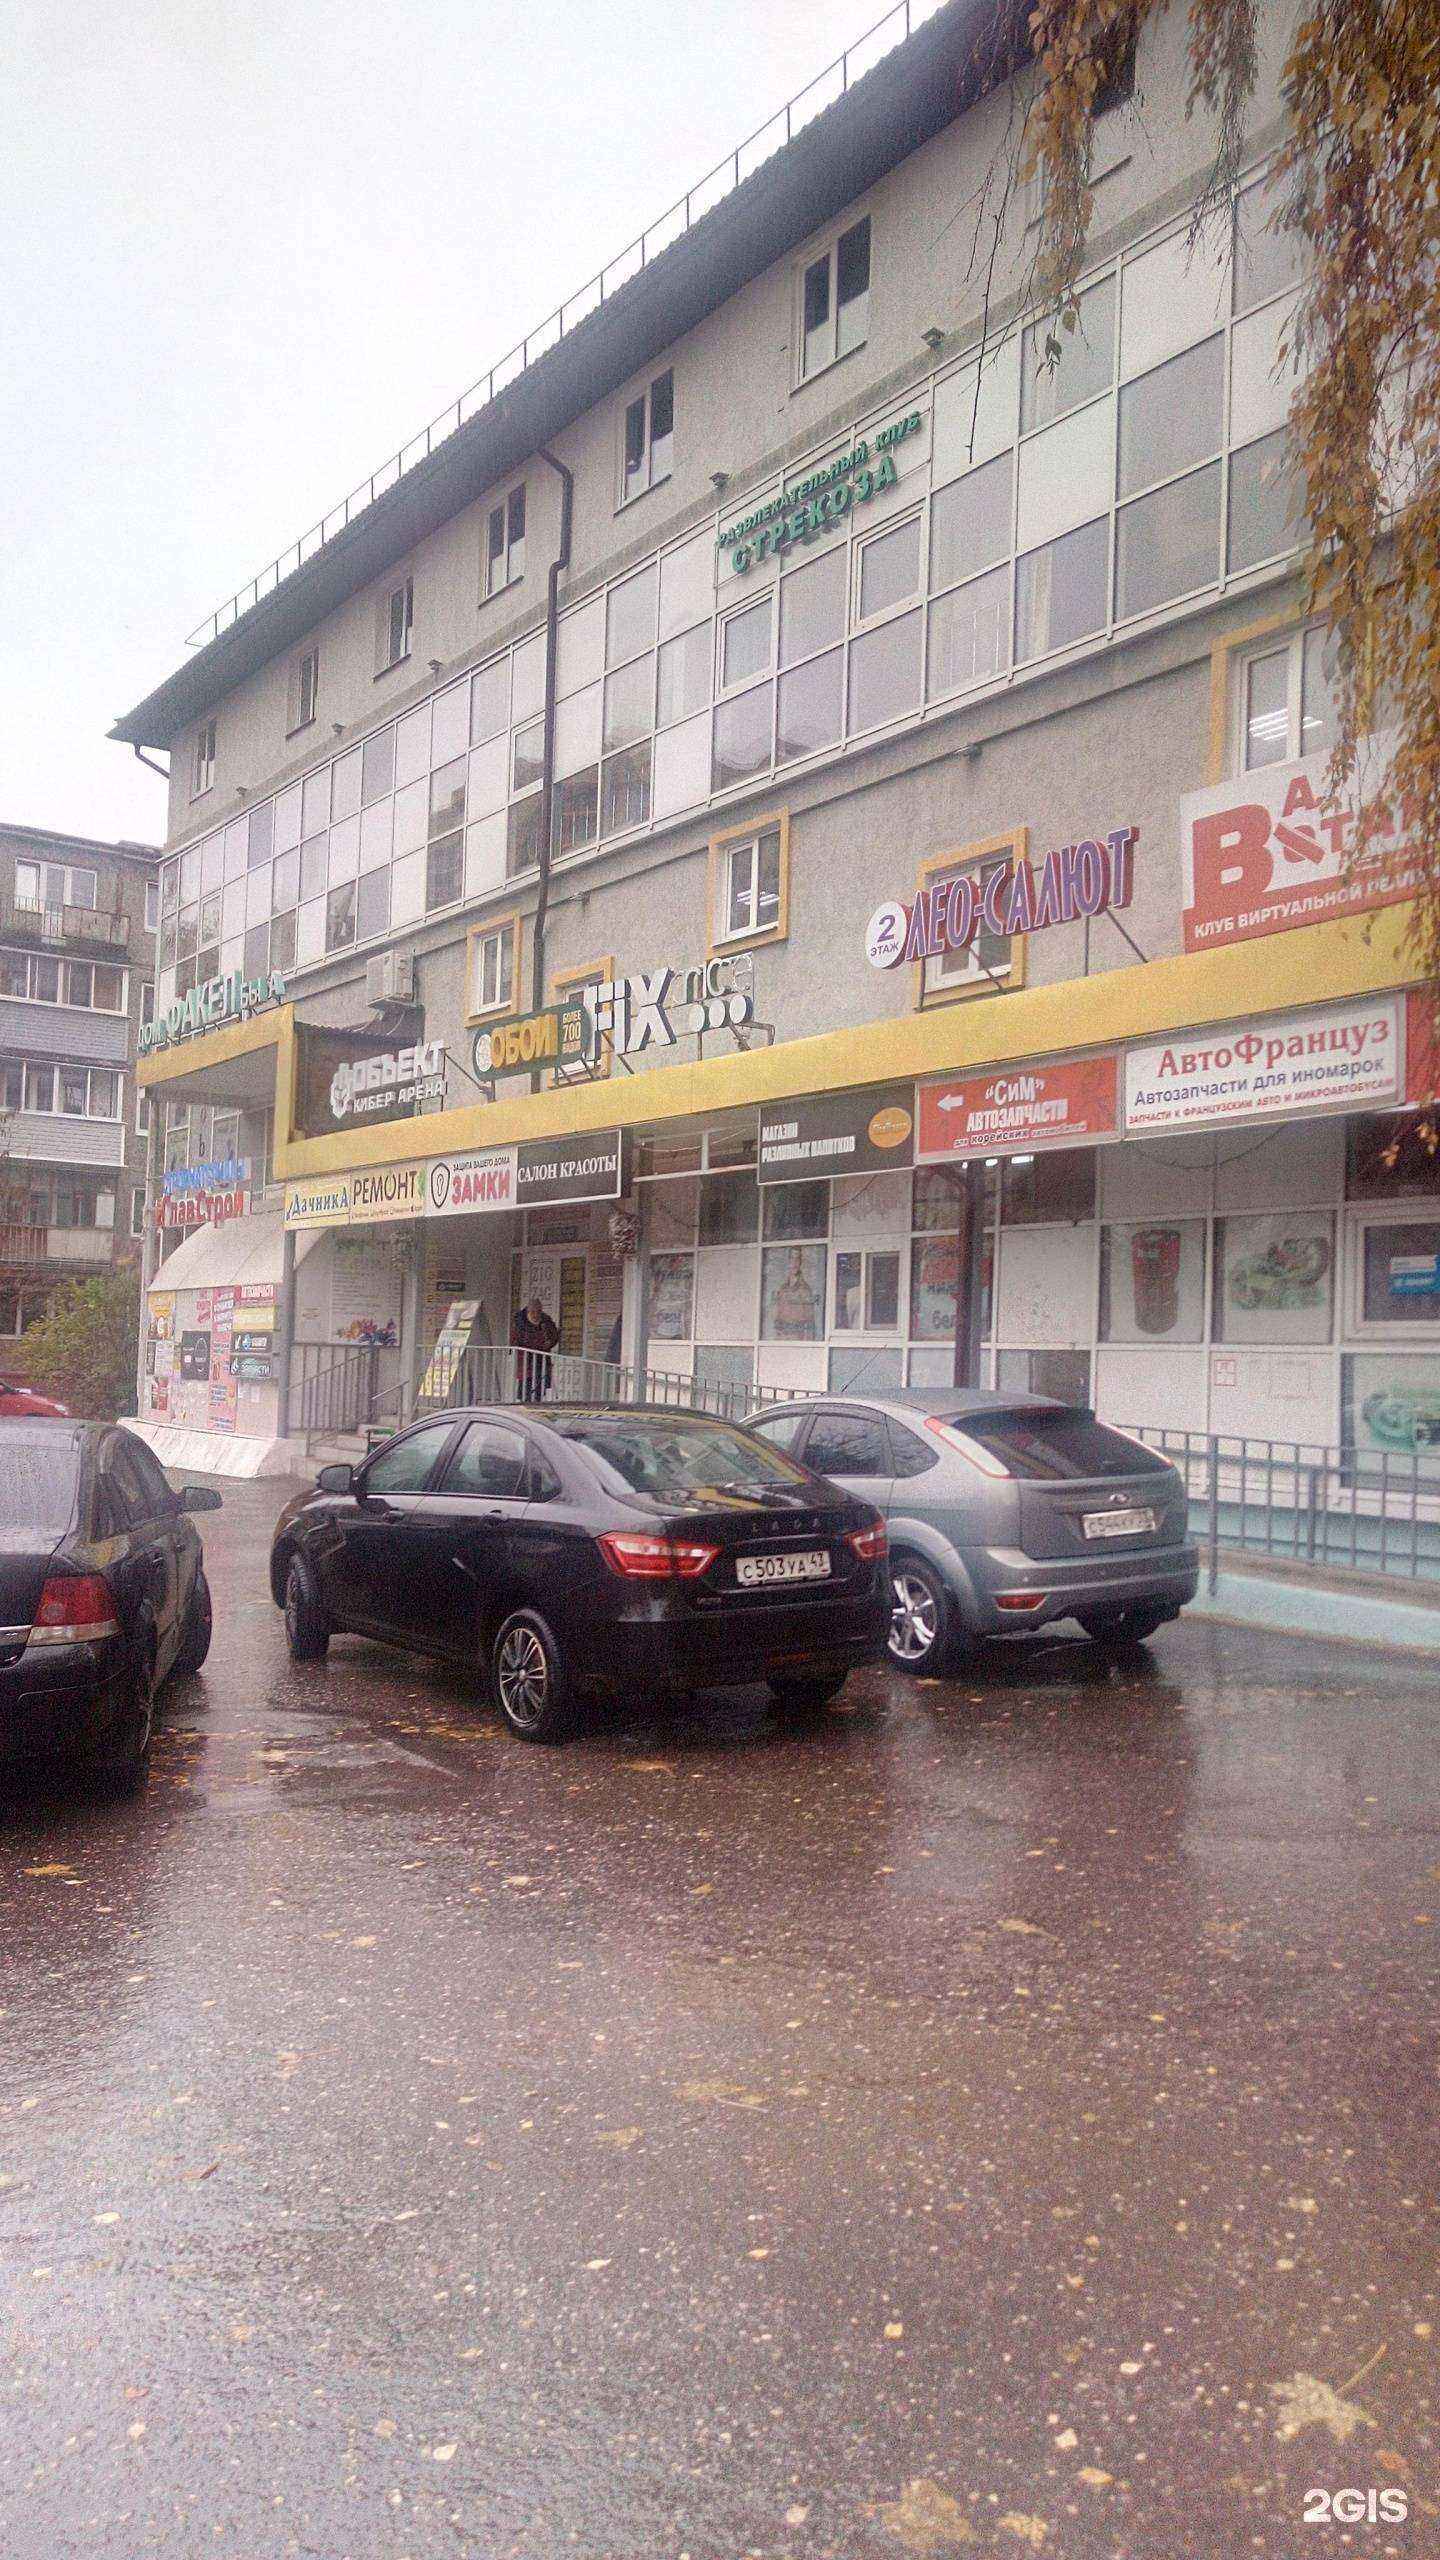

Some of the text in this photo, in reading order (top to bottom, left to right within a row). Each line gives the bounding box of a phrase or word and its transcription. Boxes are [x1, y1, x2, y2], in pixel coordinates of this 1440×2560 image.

[875, 411, 921, 451] КЛУБ
[732, 455, 897, 573] СТРЕКОЗА
[905, 828, 1139, 961] ЛЕО-САЛЮТ
[1195, 917, 1234, 938] КЛУБ
[1237, 883, 1363, 928] ВИРТУАЛЬНОЙ
[877, 914, 896, 942] 2
[869, 942, 899, 957] ЭТАЖ
[562, 1021, 582, 1042] 700
[584, 967, 675, 1062] FIX
[490, 1014, 558, 1068] ОБОИ
[1157, 1019, 1390, 1078] АвтоФранцуз
[1134, 1057, 1385, 1106] Автозапчасти для иномарок
[353, 1092, 395, 1113] КИБЕР
[966, 1099, 1069, 1133] АВТОЗАПЧАСТИ
[1128, 1110, 1172, 1125] ЗАПЧАСТИ
[452, 1169, 511, 1205] ЗАМКИ
[517, 1154, 617, 1184] САЛОН КРАСОТЫ
[352, 1170, 418, 1205] РЕМОНТ
